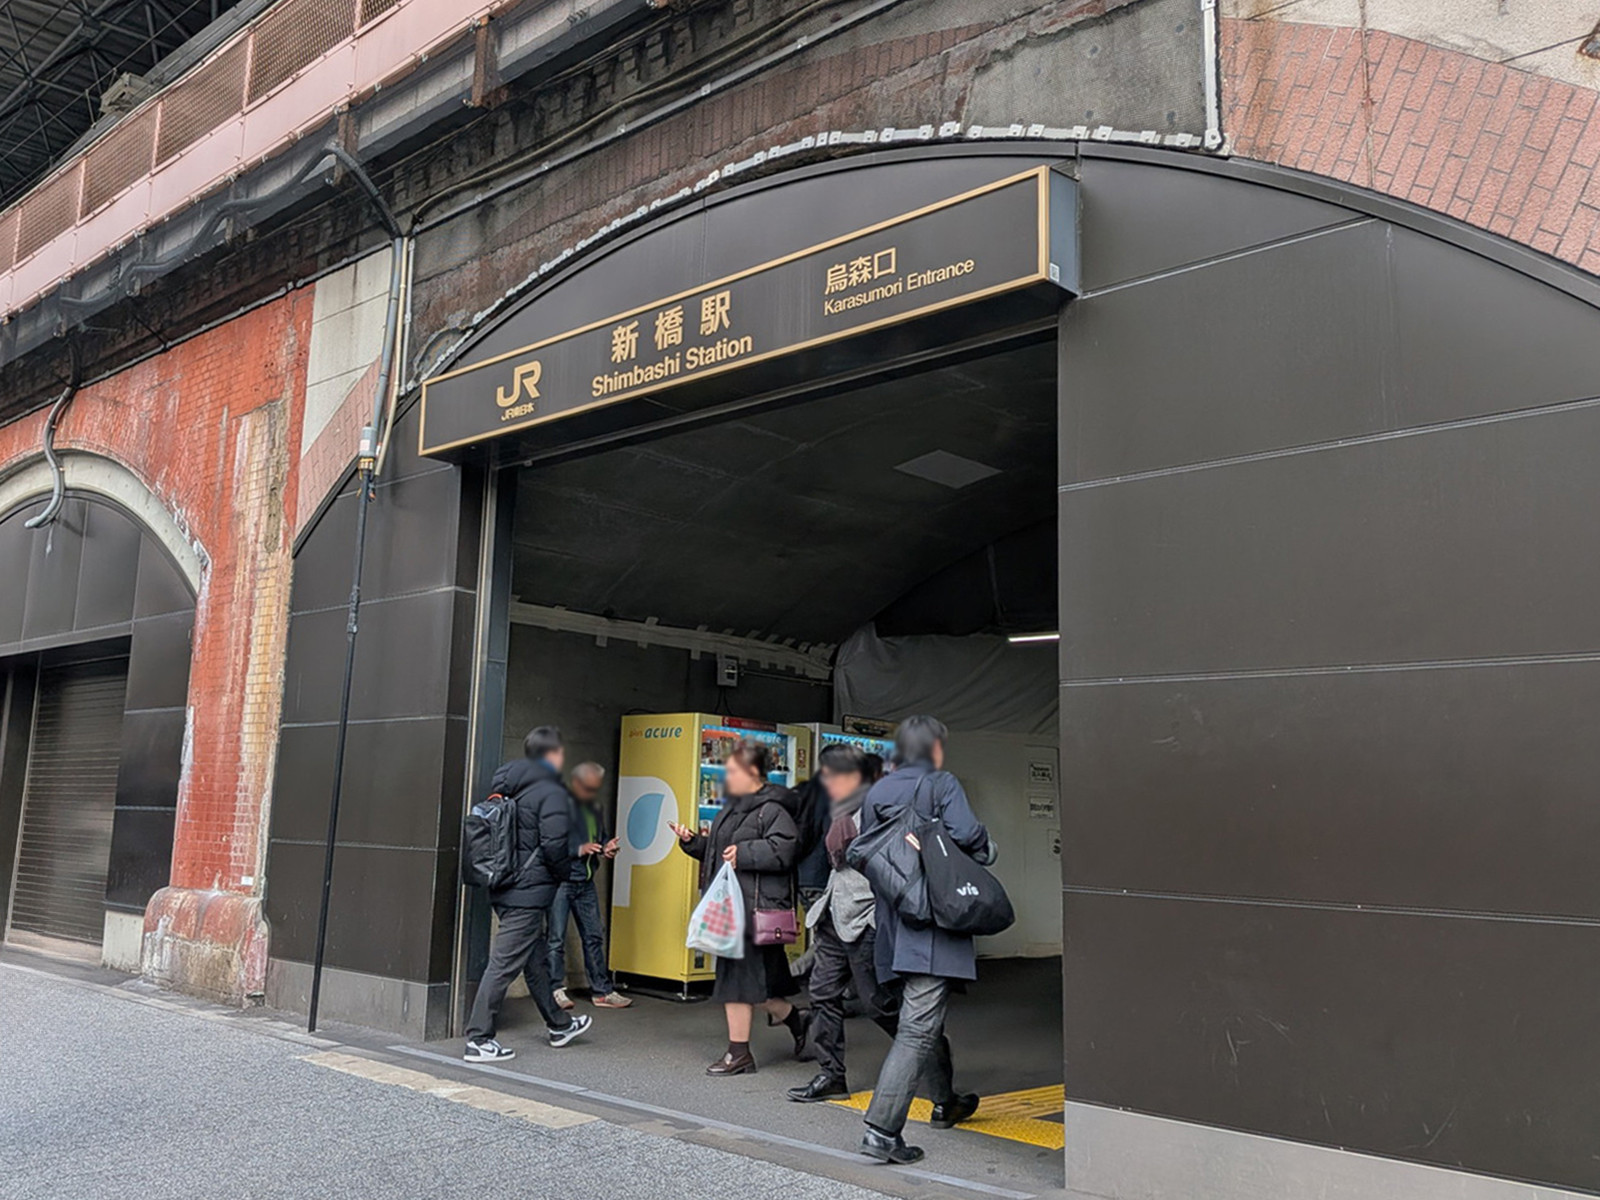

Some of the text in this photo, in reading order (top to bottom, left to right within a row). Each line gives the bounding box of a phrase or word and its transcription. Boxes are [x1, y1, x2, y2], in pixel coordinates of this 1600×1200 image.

[824, 247, 896, 295] 烏森口
[824, 258, 975, 316] Karasumori Entrance
[610, 290, 731, 363] 新橋駅
[496, 360, 541, 408] JR
[591, 335, 753, 397] Shimbashi Station
[644, 726, 683, 739] acure
[956, 882, 979, 896] vis
